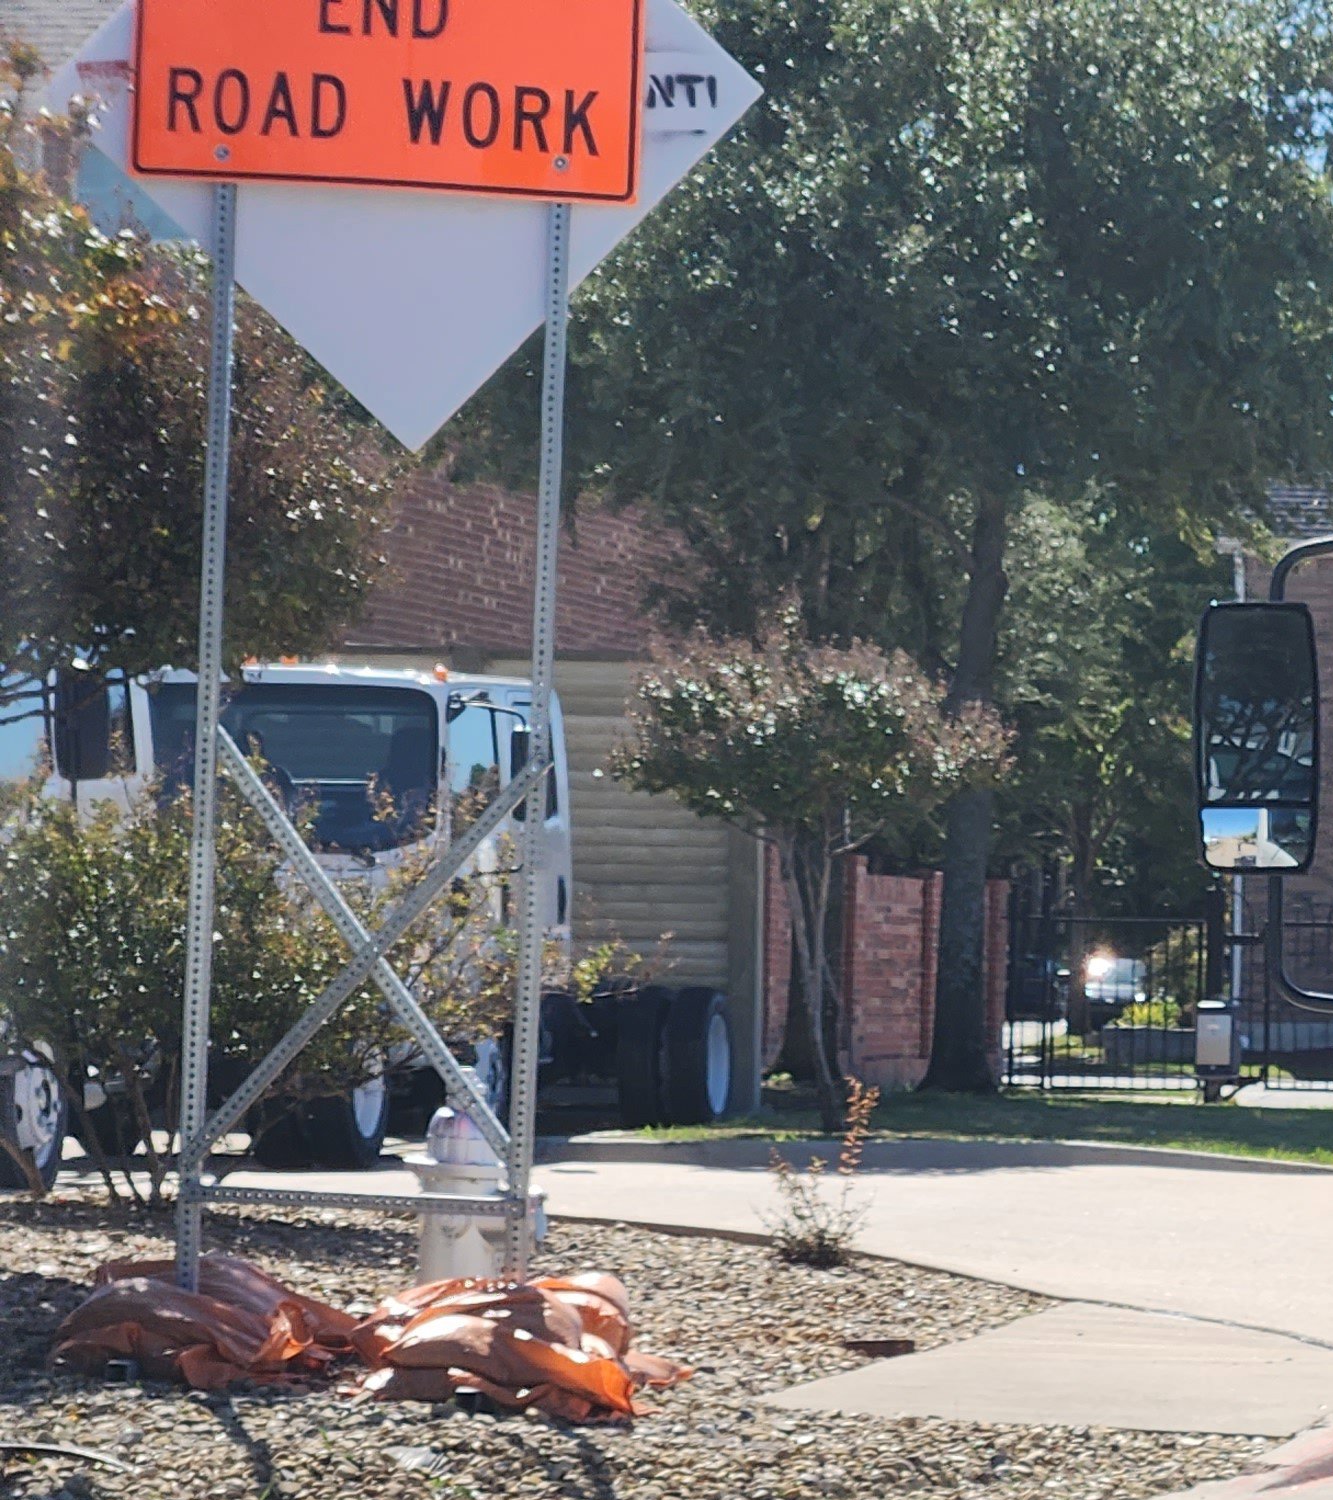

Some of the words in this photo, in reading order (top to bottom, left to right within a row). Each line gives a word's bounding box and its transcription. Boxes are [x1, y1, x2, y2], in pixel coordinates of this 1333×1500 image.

[319, 0, 447, 39] END
[167, 67, 346, 139] ROAD
[402, 78, 599, 156] WORK
